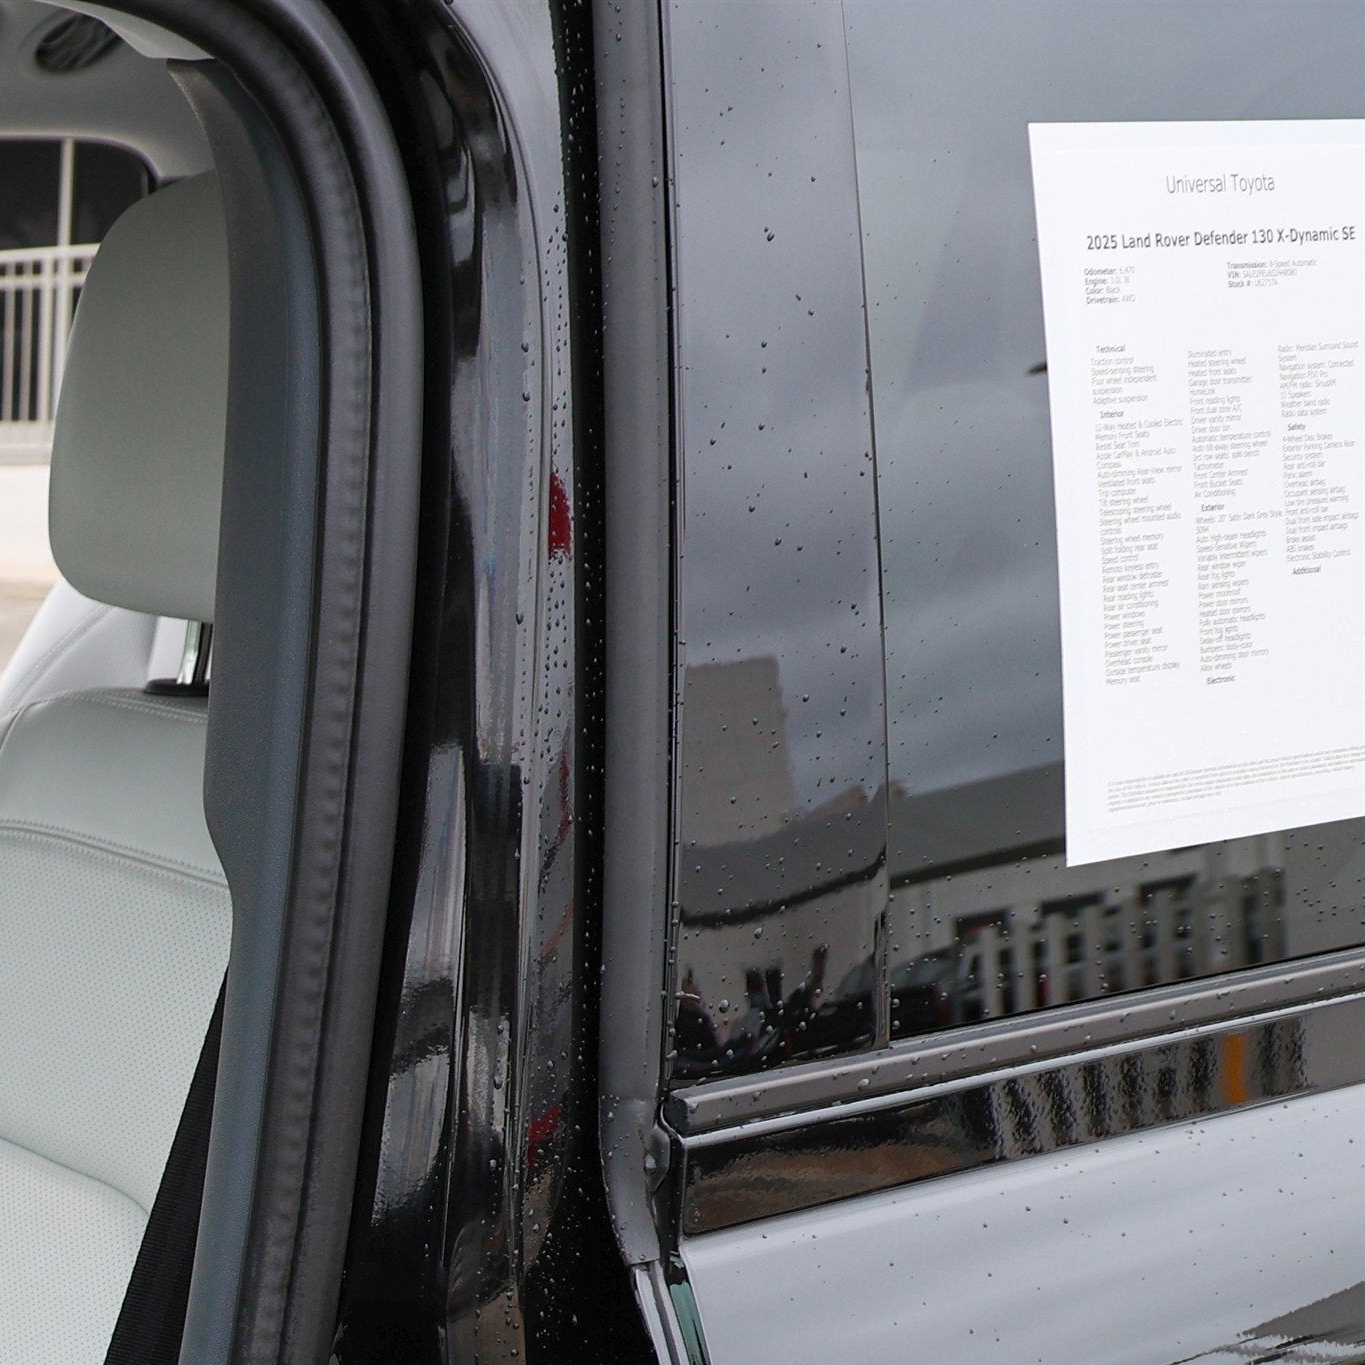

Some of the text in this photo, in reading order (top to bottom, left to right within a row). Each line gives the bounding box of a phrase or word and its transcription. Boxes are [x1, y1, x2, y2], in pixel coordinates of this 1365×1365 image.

[1166, 173, 1275, 196] Universal Toyota
[1086, 226, 1356, 251] 2025 Land Rover Defender 130 X-Dynamic SE
[1227, 261, 1267, 270] Transmission:
[1084, 267, 1118, 276] Odometer:
[1227, 271, 1240, 279] VIN:
[1084, 277, 1109, 288] Engine:
[1228, 280, 1245, 288] Stock
[1085, 287, 1104, 295] Color:
[1086, 296, 1120, 305] Drivetrain:
[1096, 344, 1126, 353] Technical
[1100, 410, 1125, 419] Interior
[1287, 423, 1306, 433] Safety
[1201, 503, 1225, 512] Exterior
[1292, 565, 1321, 575] Additional
